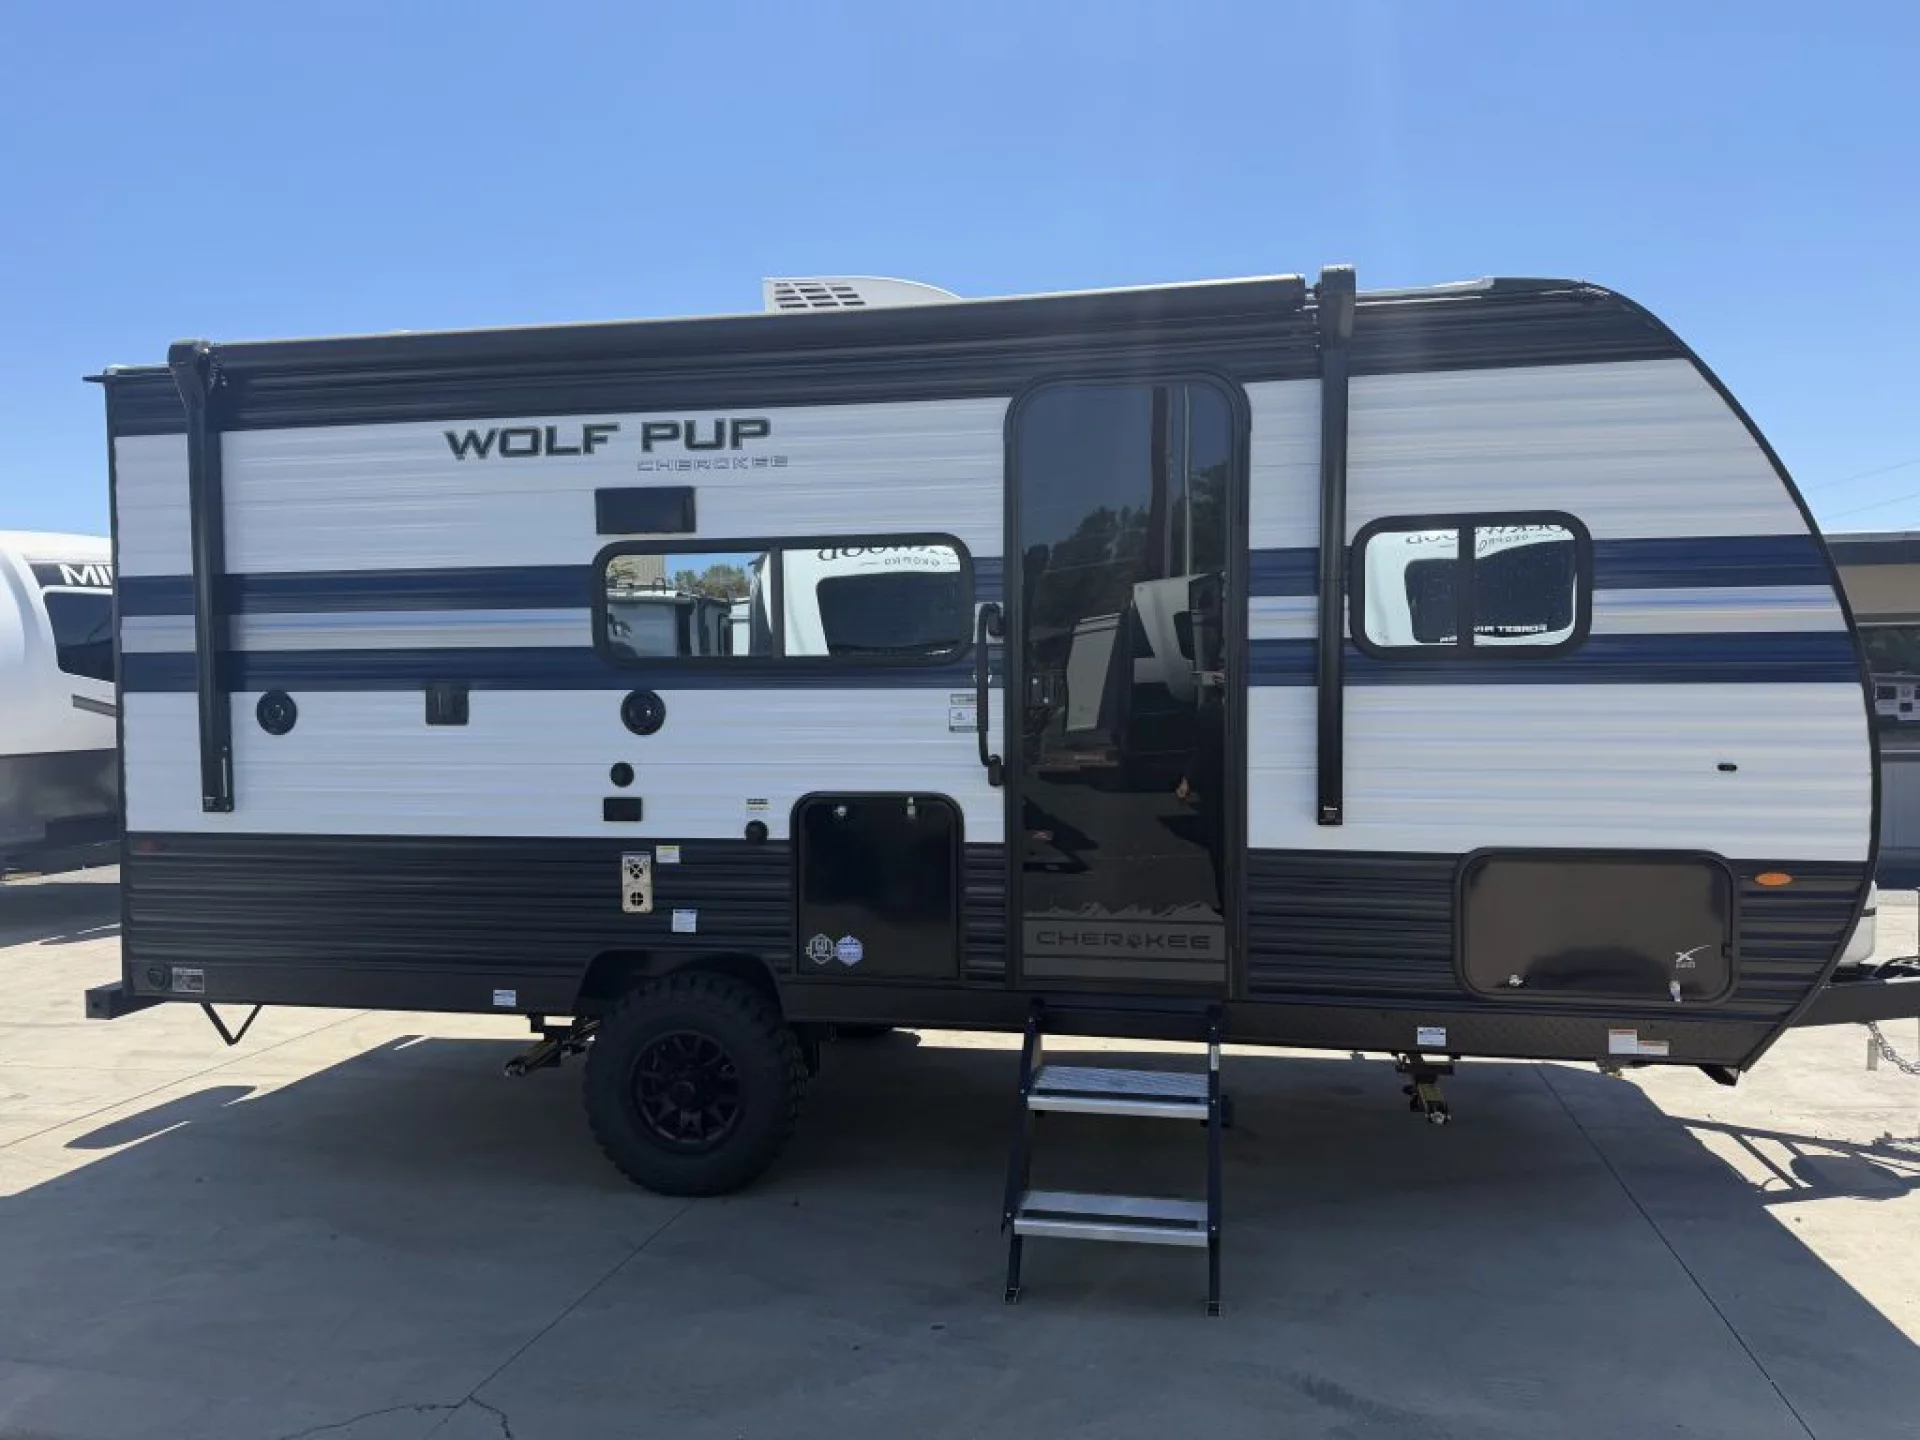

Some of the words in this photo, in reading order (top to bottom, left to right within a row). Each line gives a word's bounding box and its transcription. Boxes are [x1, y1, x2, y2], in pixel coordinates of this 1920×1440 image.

[444, 422, 620, 461] WOLF
[640, 417, 771, 453] PUP
[637, 455, 789, 472] CHEROKEE
[1036, 931, 1212, 950] CHEROKEE
